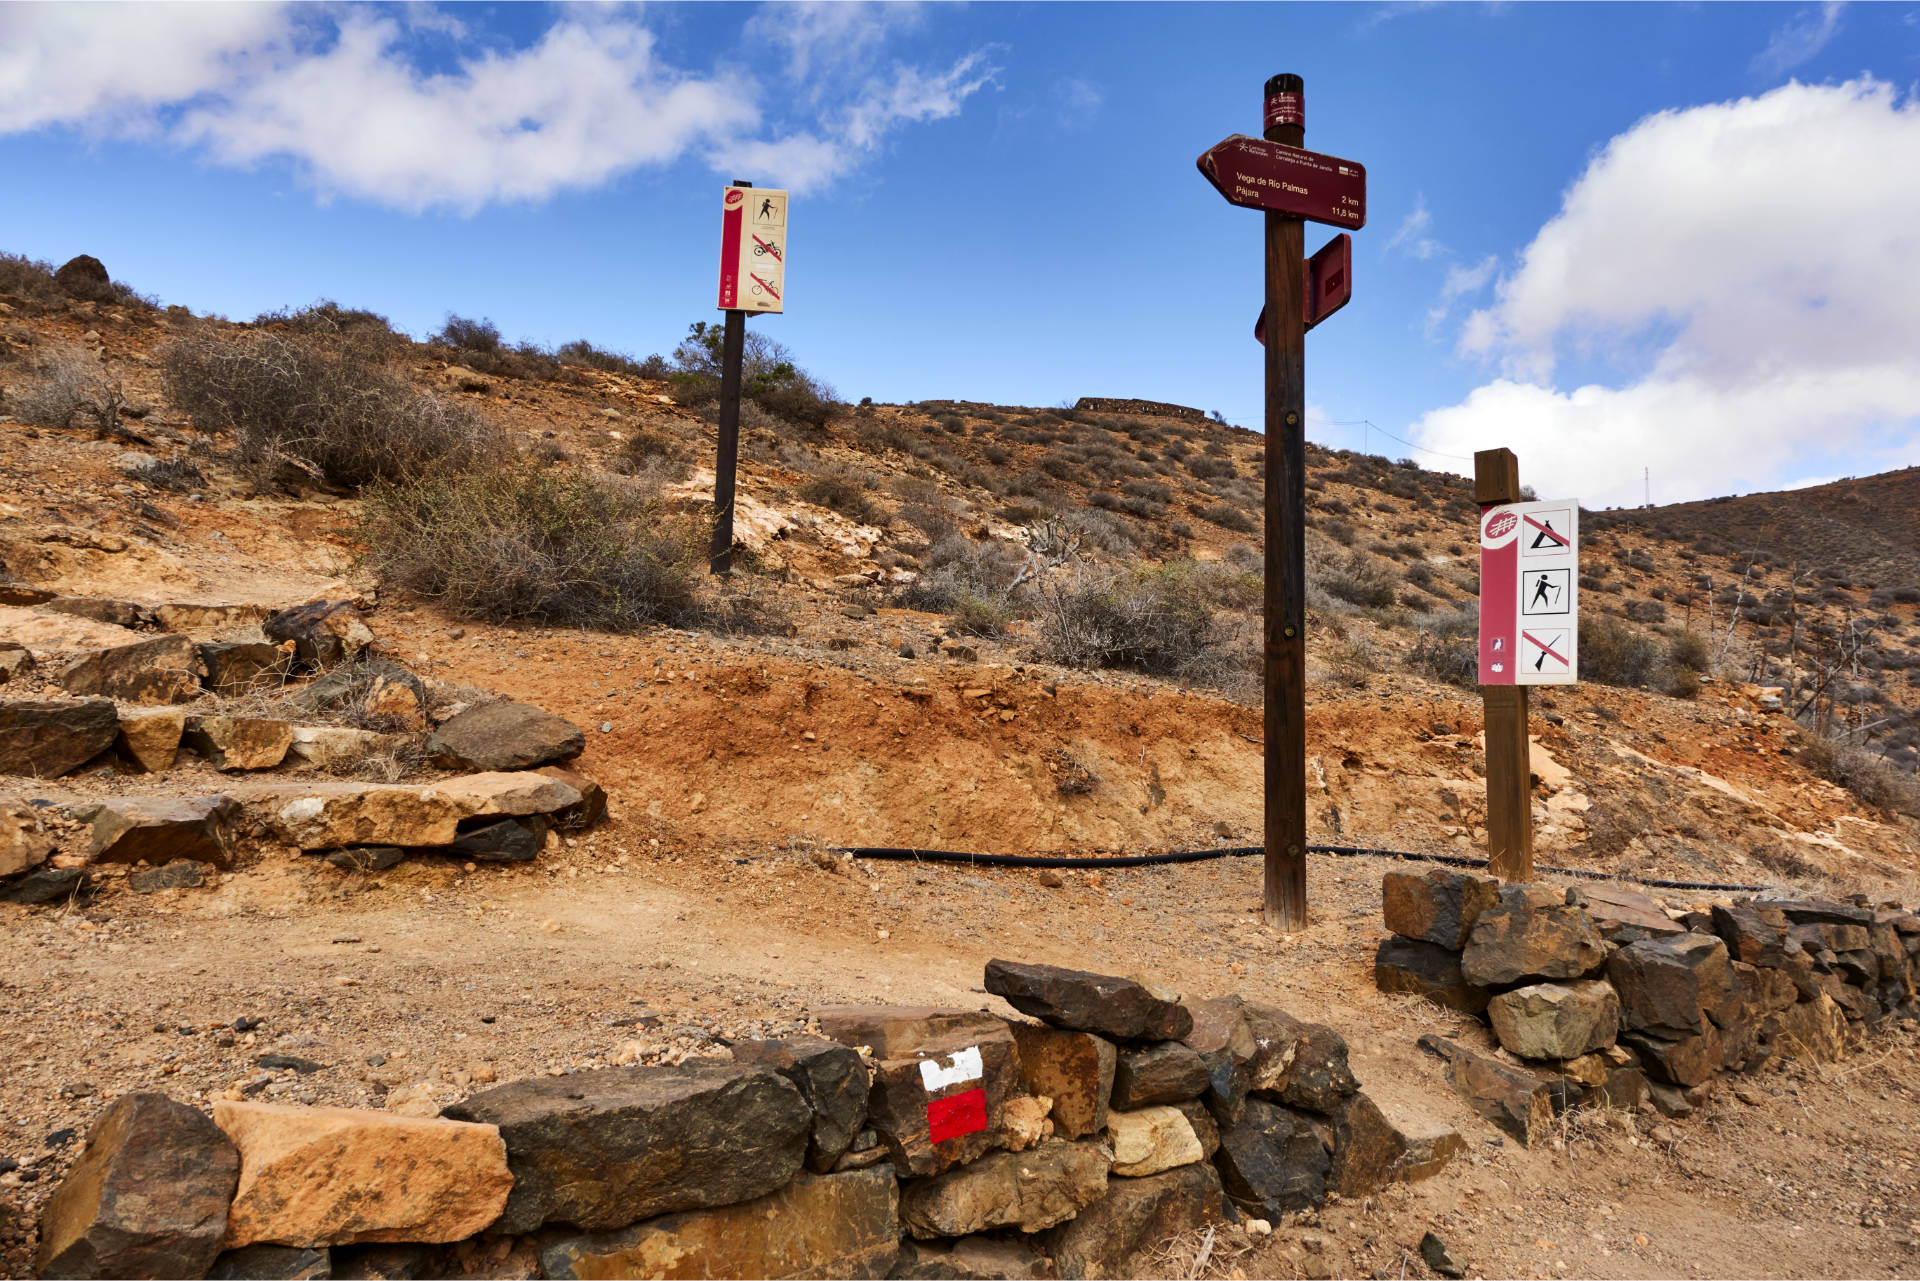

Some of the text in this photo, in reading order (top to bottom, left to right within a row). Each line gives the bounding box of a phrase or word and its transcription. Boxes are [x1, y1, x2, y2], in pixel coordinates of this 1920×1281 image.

[1236, 171, 1308, 195] Vega de Río Palmas
[1235, 185, 1259, 198] Pájara
[1341, 195, 1359, 206] 2 km
[1332, 206, 1359, 220] 11,8 km
